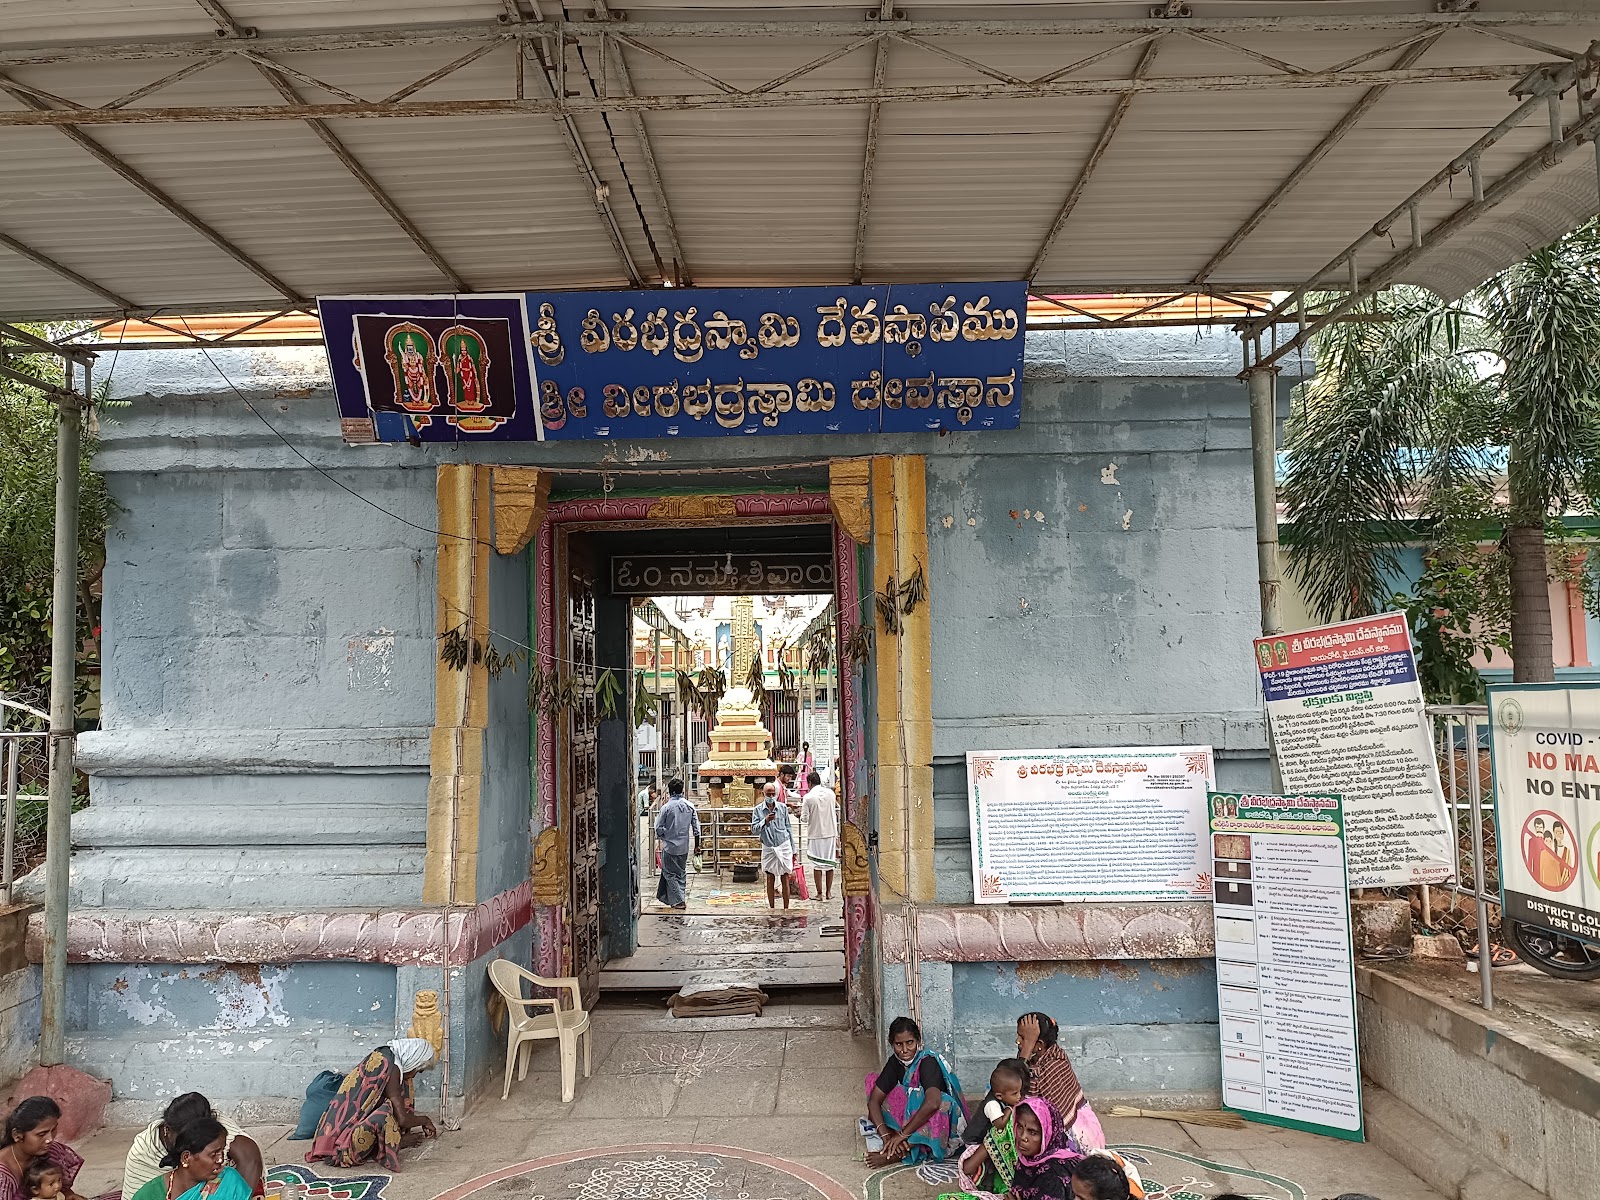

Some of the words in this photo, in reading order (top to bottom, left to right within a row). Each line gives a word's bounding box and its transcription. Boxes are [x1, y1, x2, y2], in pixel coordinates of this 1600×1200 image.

[530, 302, 564, 366] శ్రీ
[580, 306, 800, 363] వీరభద్రస్వామి
[817, 296, 1018, 358] దేవస్థానము
[541, 380, 586, 430] ಶ್ರೀ
[602, 376, 836, 428] ವೀರಭದ್ರಸ್ವಾಮಿ
[852, 368, 1016, 424] ದೇವಸ್ಥಾನ
[618, 560, 662, 587] ಓಂ
[746, 560, 834, 585] ಶಿವಾಯ
[1303, 694, 1343, 708] భక్తులకు
[1345, 691, 1373, 704] విజ్ఞప్తి
[1536, 732, 1583, 746] COVID
[1528, 752, 1557, 770] NO
[1527, 778, 1554, 796] NO
[1527, 900, 1575, 920] DISTRICT
[1547, 916, 1569, 930] YSR
